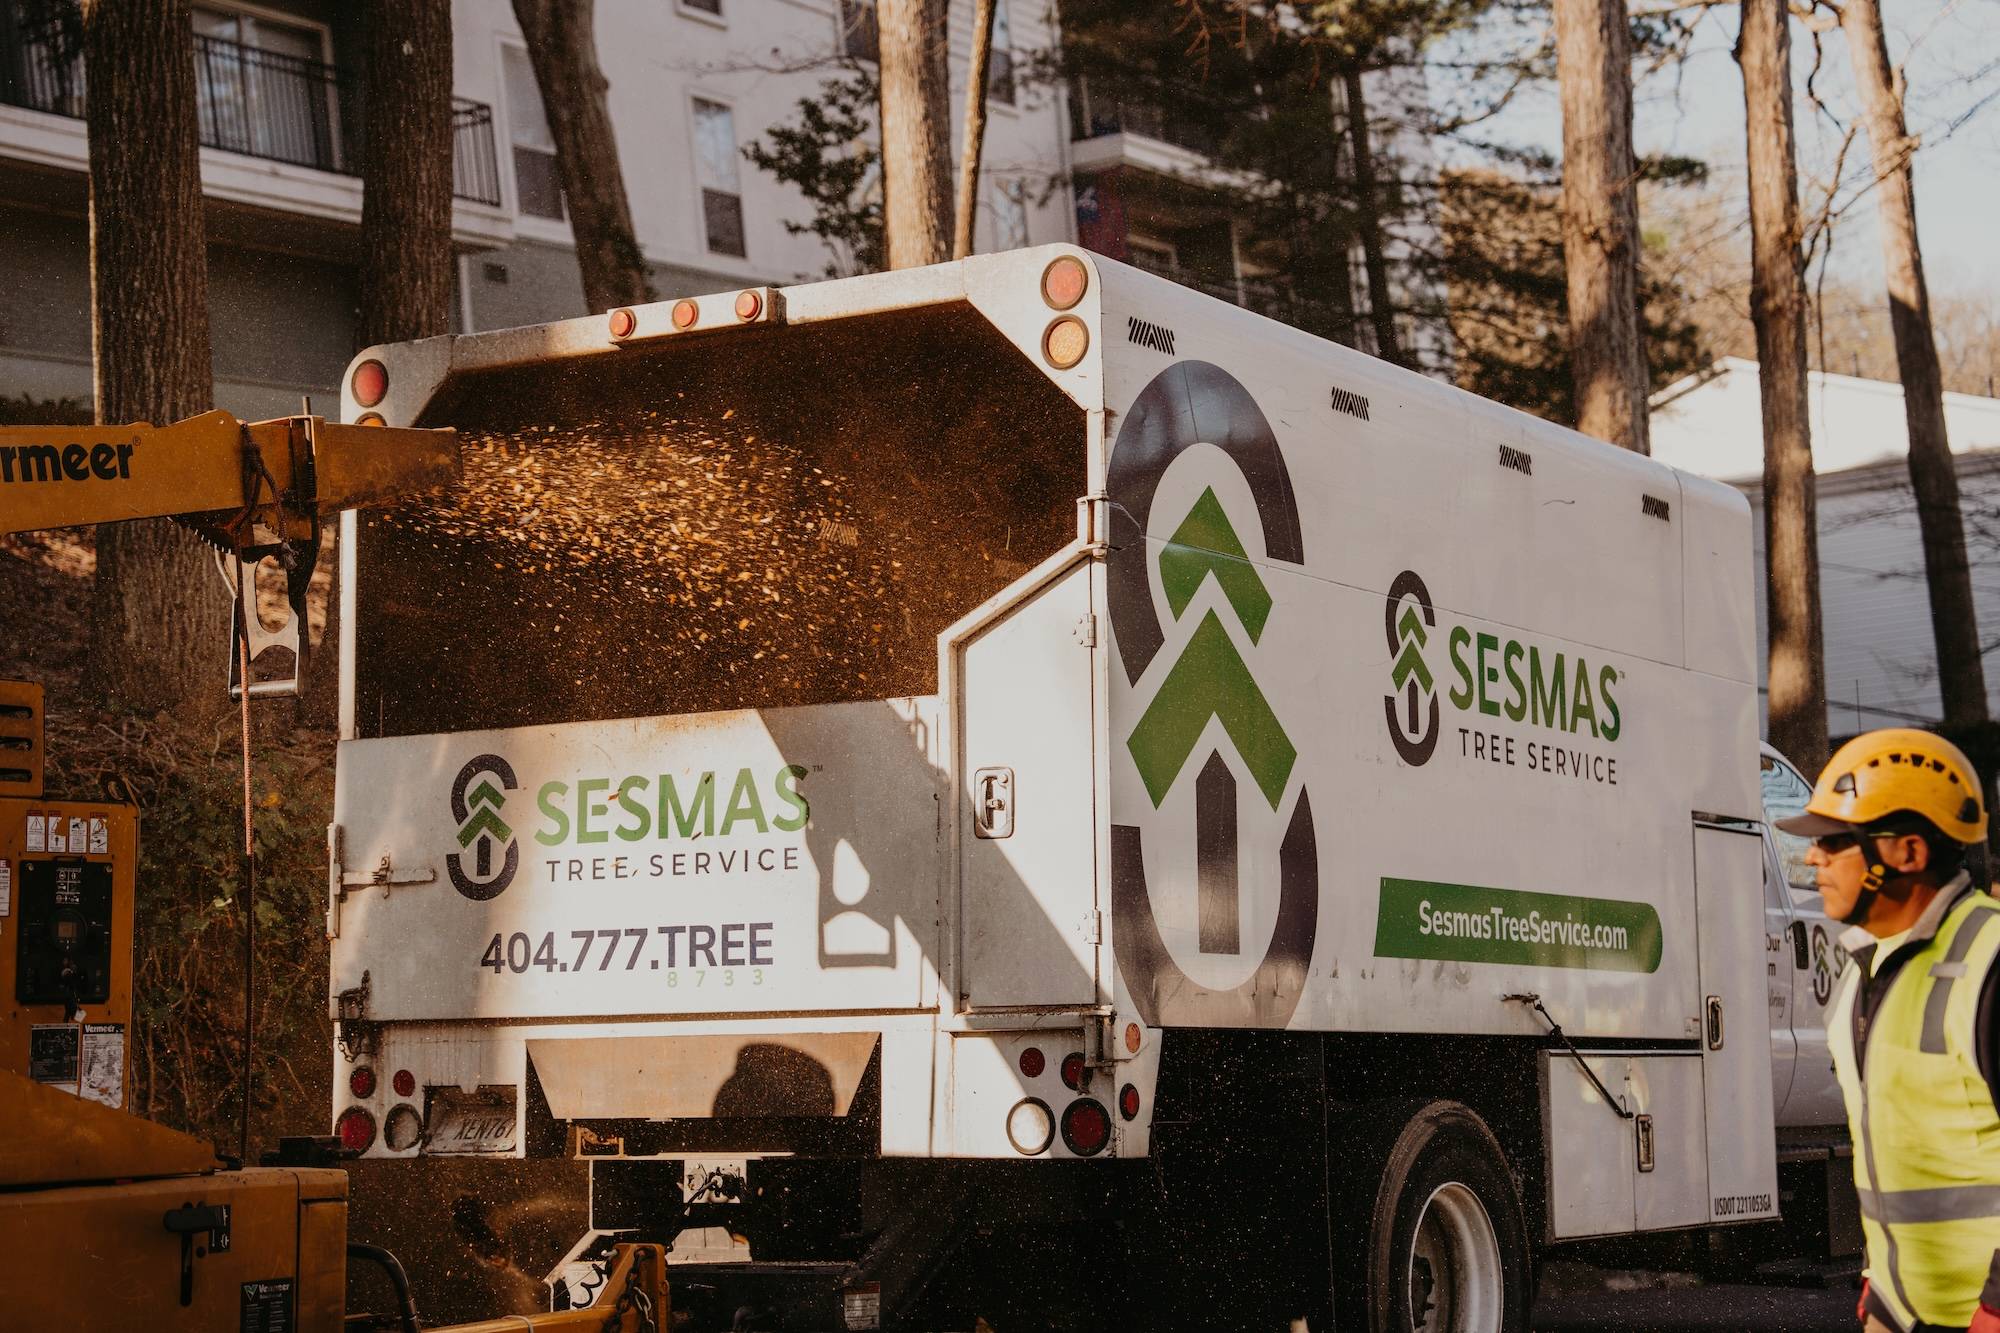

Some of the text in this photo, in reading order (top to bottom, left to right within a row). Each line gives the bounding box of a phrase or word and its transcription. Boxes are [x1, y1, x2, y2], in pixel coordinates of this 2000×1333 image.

[1448, 625, 1621, 742] SESMAS
[1458, 728, 1617, 785] TREE SERVICE
[534, 764, 810, 847] SESMAS
[546, 847, 798, 882] TREE SERVICE
[481, 923, 774, 974] 404.777.TREE
[1419, 900, 1628, 951] SesmasTreeService.com
[85, 1024, 115, 1033] Vermeer
[1714, 1196, 1735, 1216] USDOT
